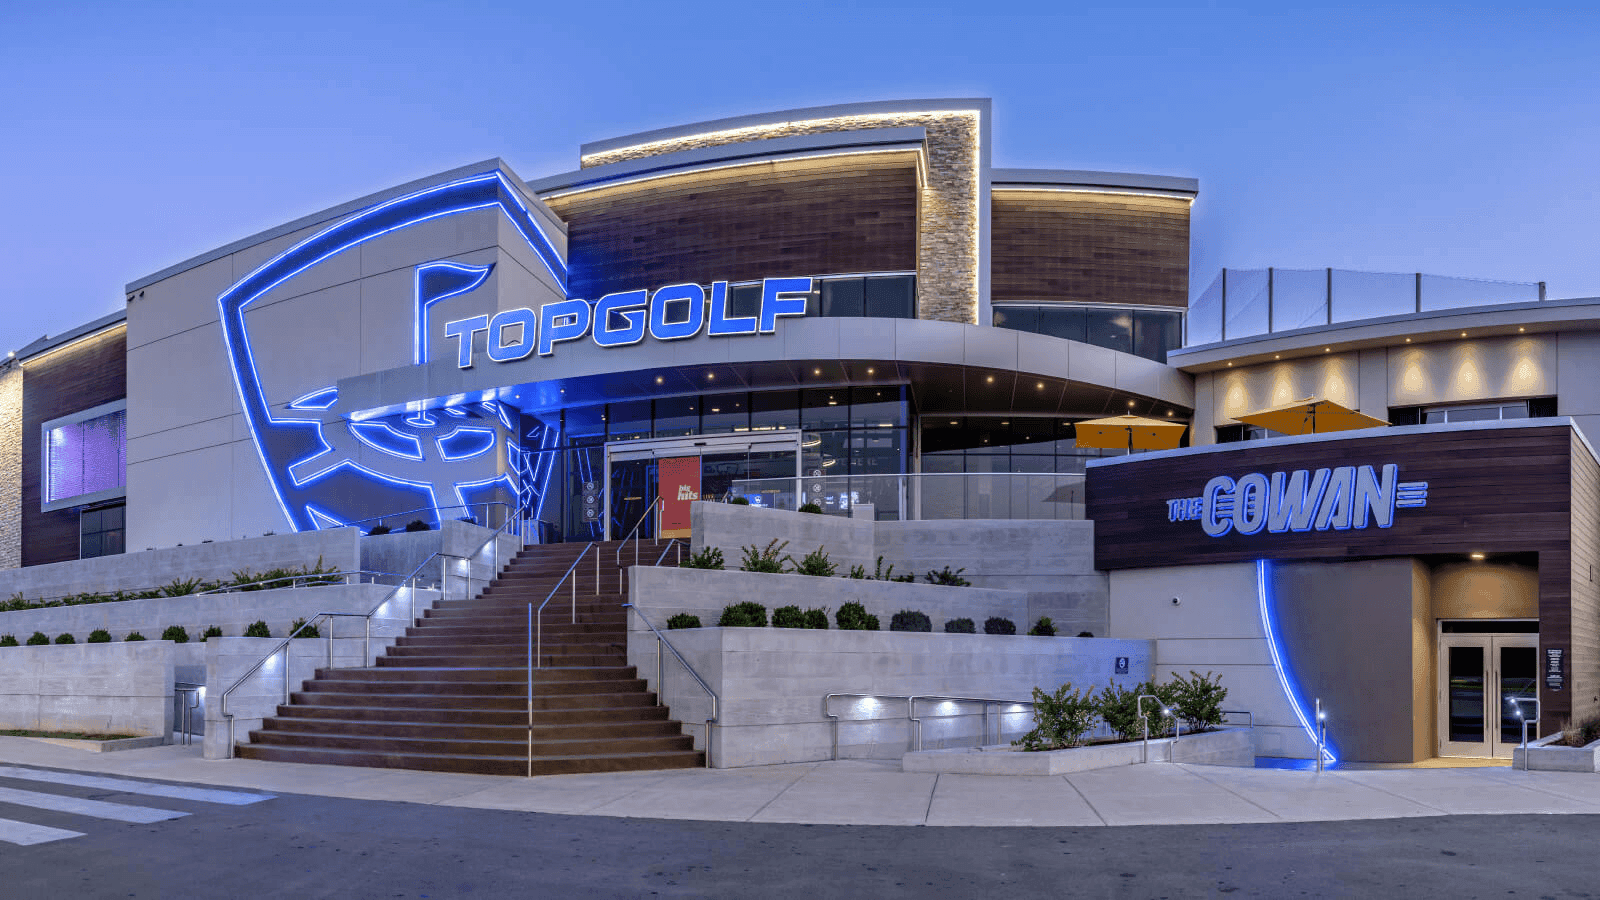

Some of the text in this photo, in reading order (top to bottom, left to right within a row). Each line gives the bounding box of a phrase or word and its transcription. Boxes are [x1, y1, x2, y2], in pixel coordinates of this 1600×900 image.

[445, 277, 813, 369] TOPGOLF
[677, 489, 699, 501] hits
[1166, 464, 1398, 537] THE COWAN
